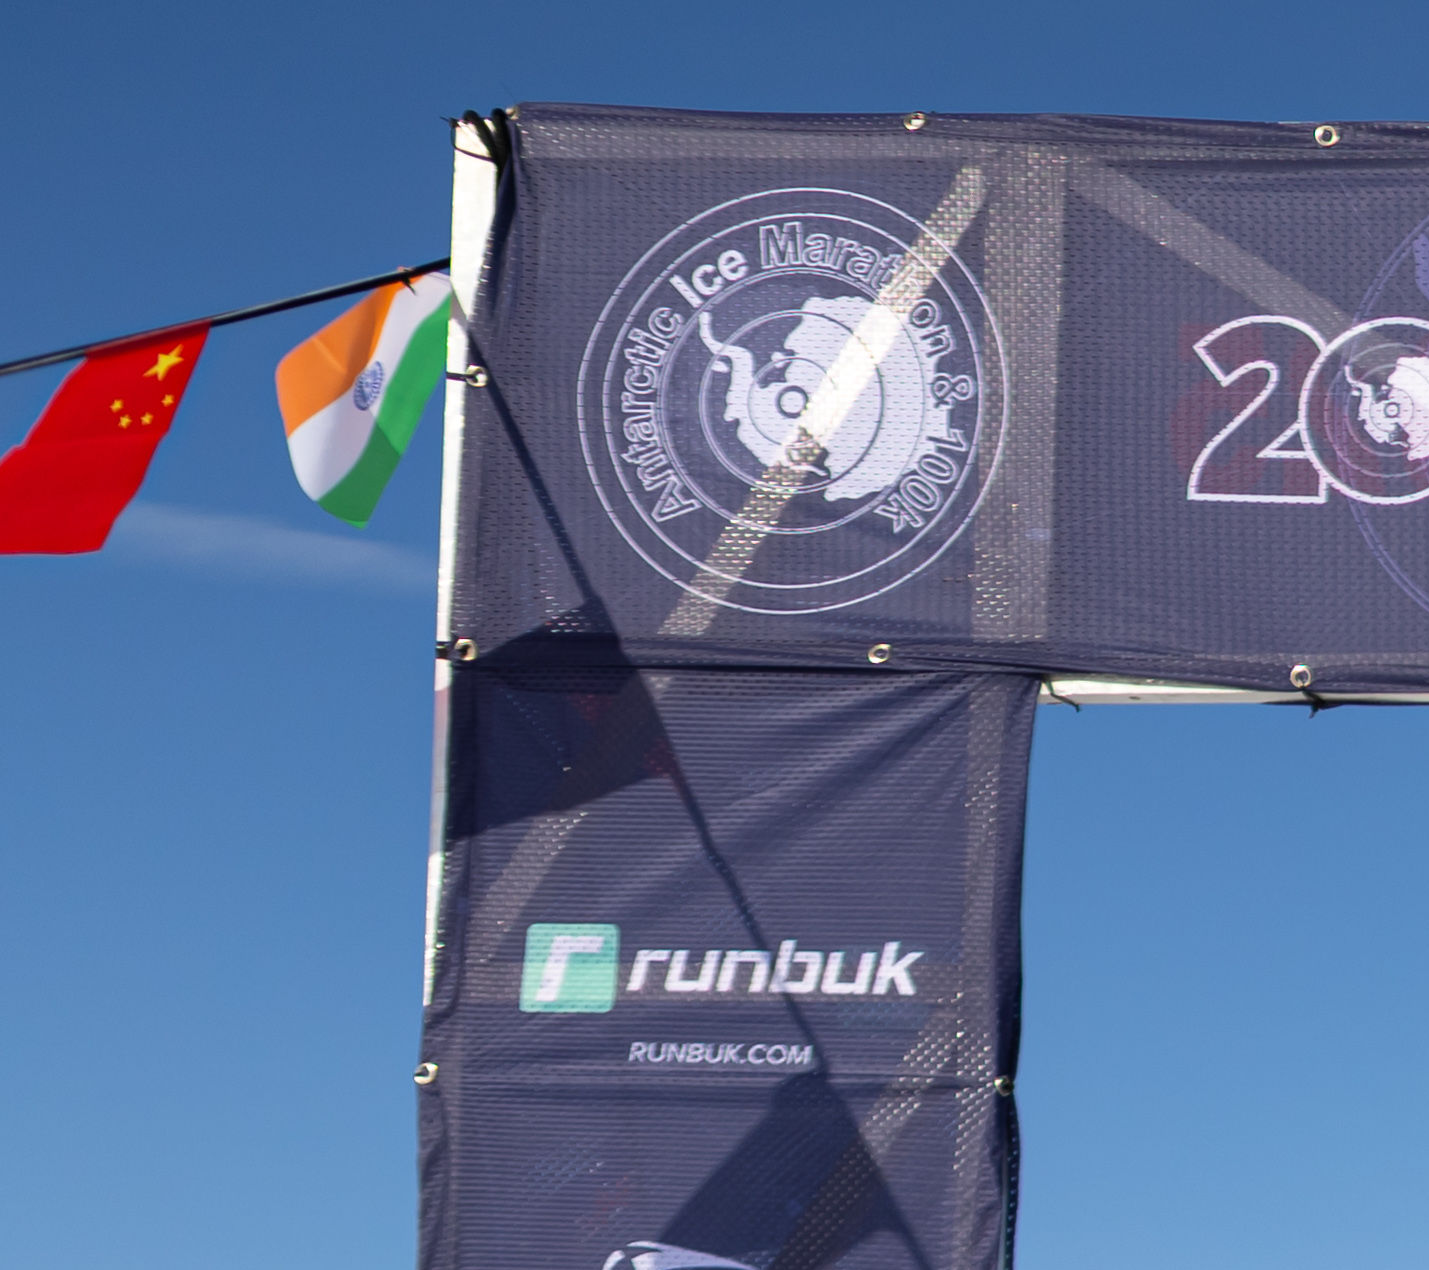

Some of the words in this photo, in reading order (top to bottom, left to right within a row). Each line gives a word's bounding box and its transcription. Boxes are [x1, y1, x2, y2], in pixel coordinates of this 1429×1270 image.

[621, 306, 702, 522] Antarctic
[669, 249, 749, 308] Ice
[932, 373, 974, 409] &
[626, 939, 925, 996] runbuk
[629, 1041, 814, 1065] RUNBUK.COM
